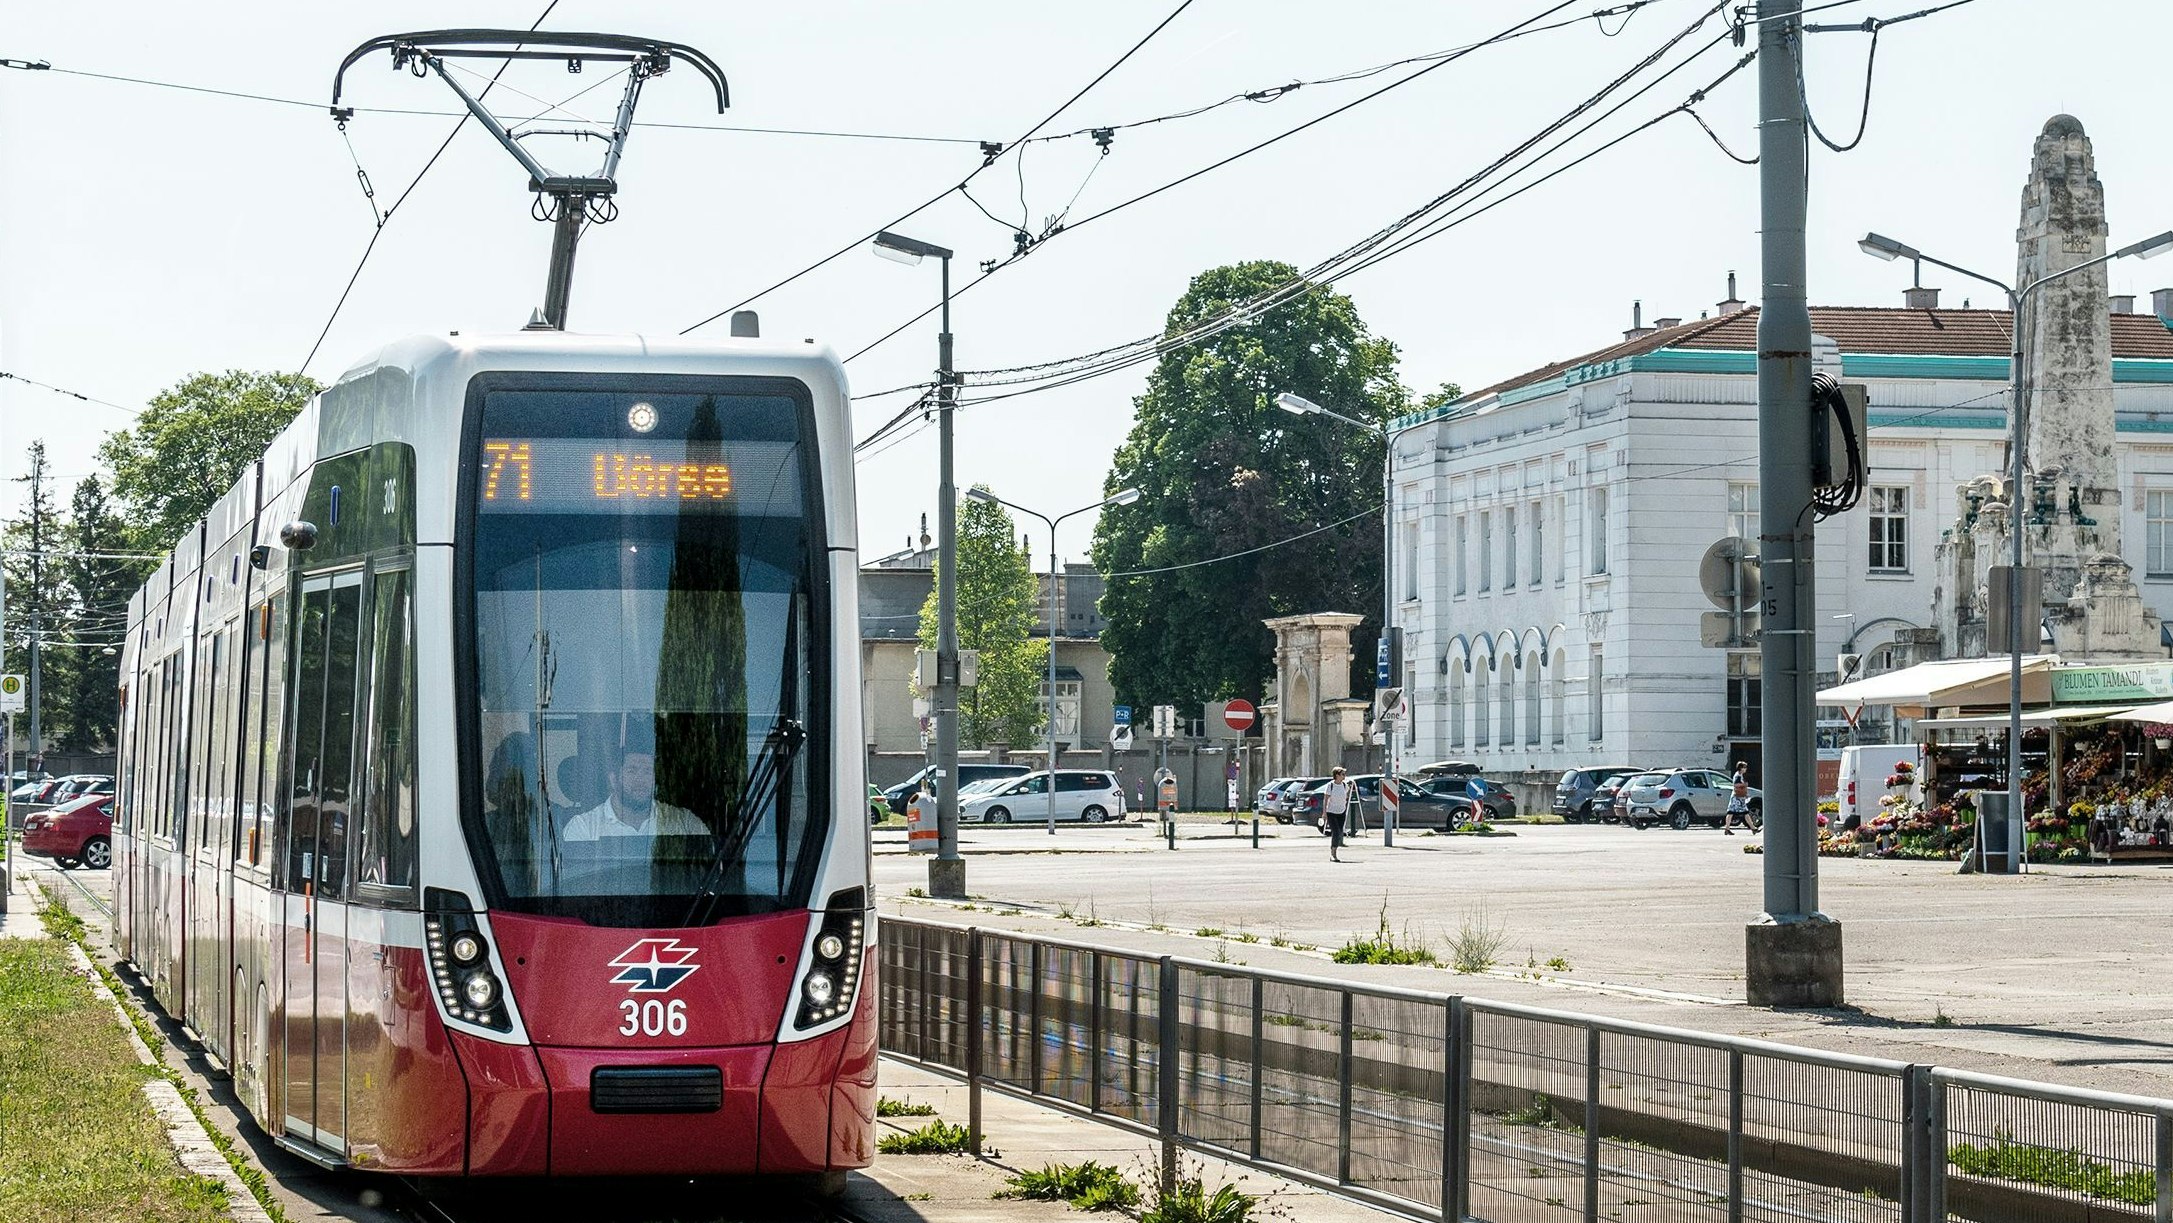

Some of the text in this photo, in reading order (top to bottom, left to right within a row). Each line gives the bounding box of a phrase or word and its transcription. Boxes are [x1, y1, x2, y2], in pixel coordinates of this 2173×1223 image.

[485, 443, 729, 498] 71 Börse
[383, 477, 397, 515] 306
[2064, 670, 2144, 689] BLUMEN TAMANDL
[1382, 710, 1399, 720] Zone
[619, 998, 687, 1037] 306
